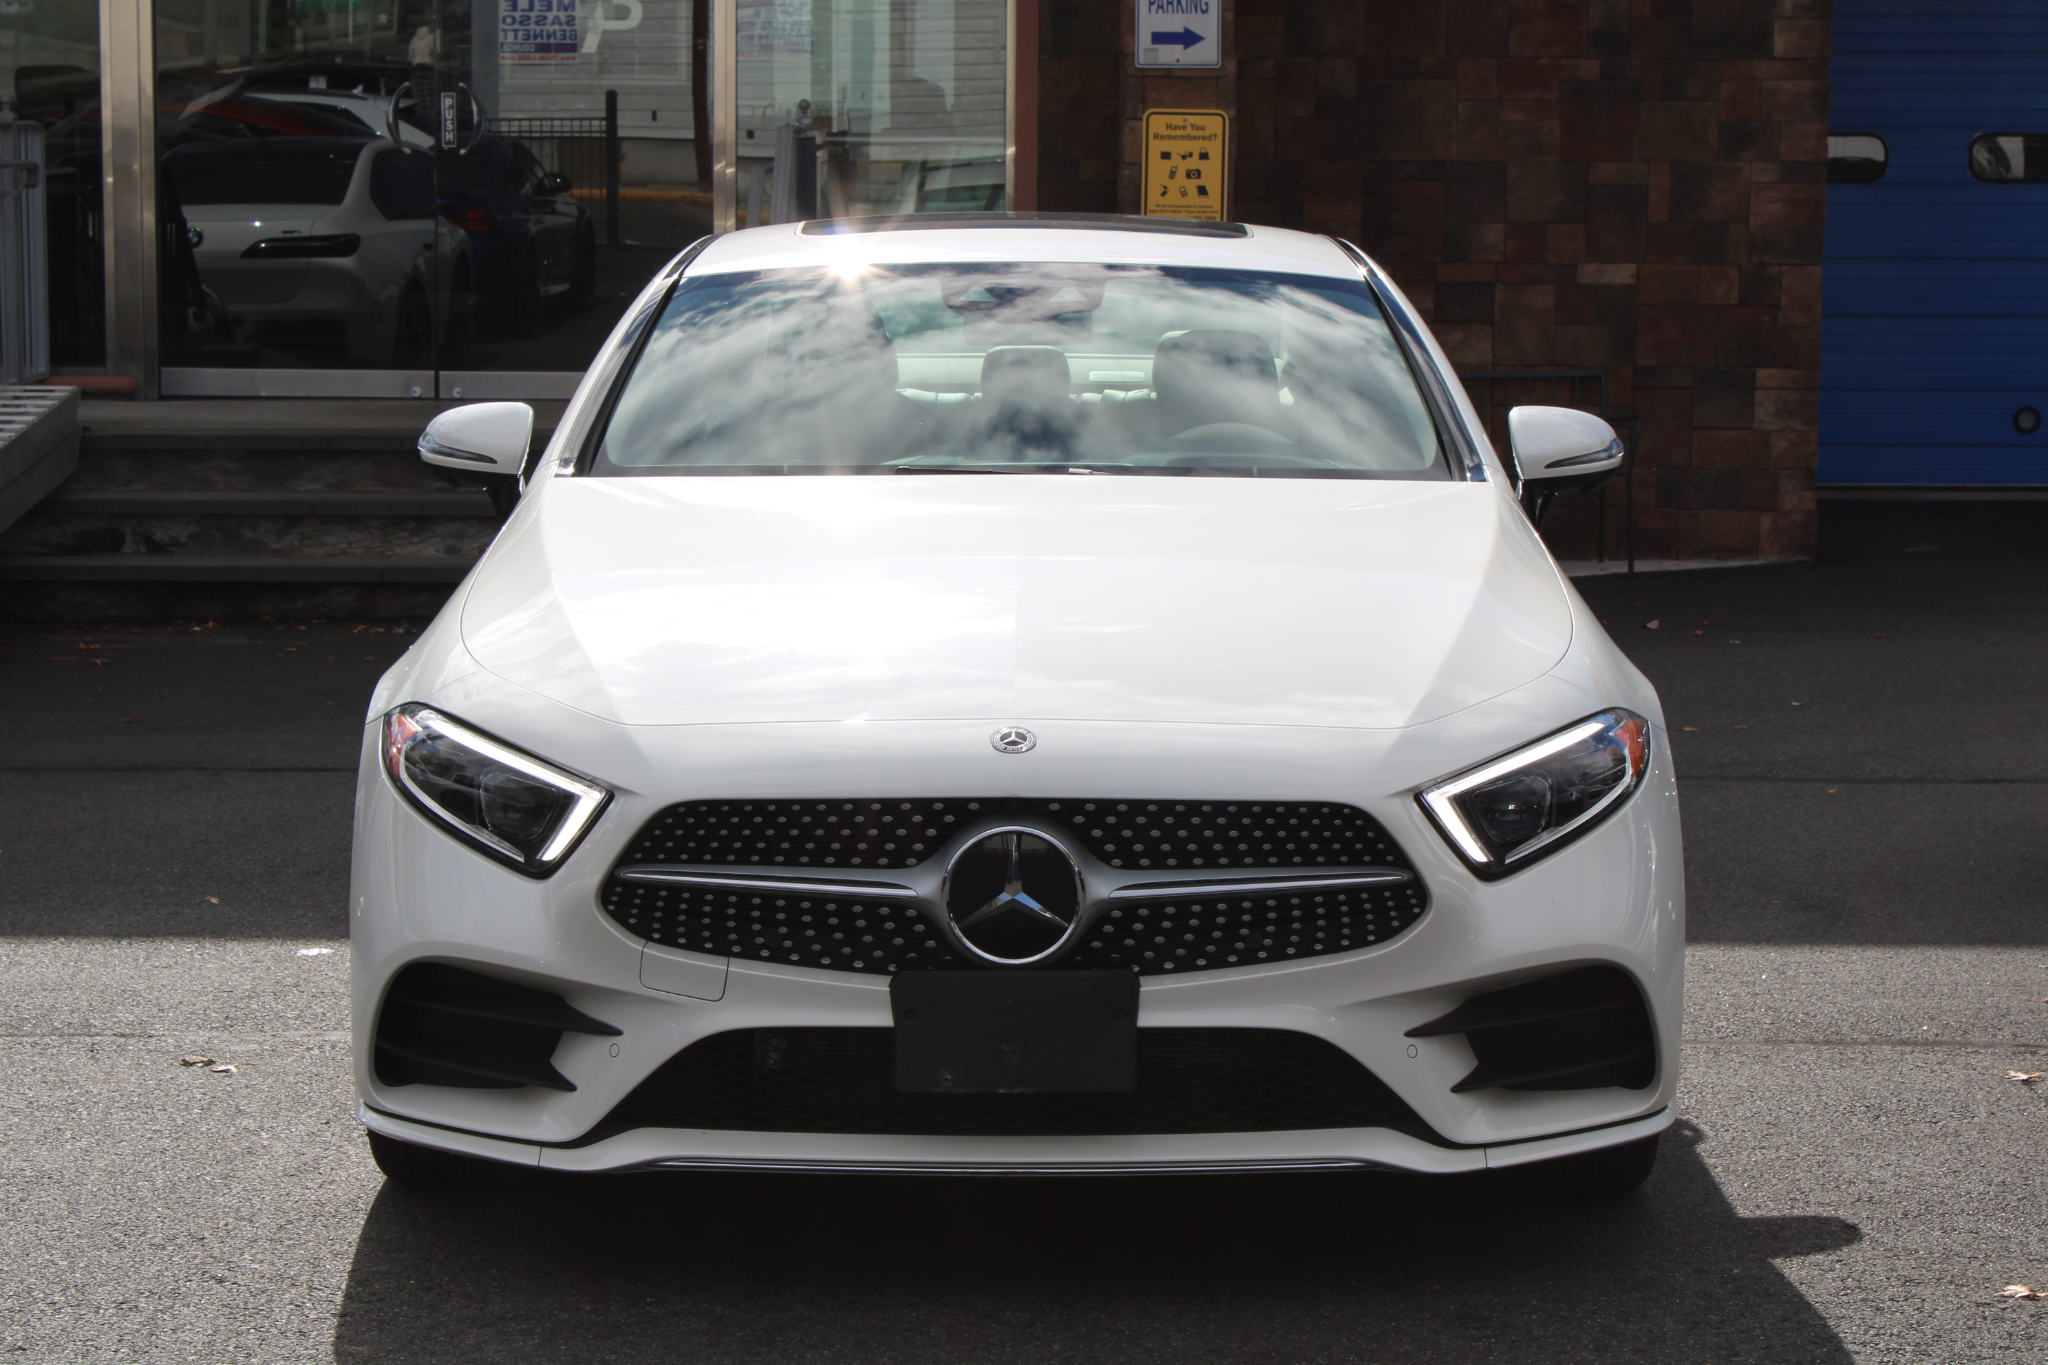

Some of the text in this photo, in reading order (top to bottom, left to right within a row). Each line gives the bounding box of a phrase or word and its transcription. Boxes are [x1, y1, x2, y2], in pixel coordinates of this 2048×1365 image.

[1148, 0, 1209, 14] PARKING
[444, 98, 453, 142] PUSH
[1166, 123, 1206, 131] Have You
[1153, 133, 1218, 142] Remembered?
